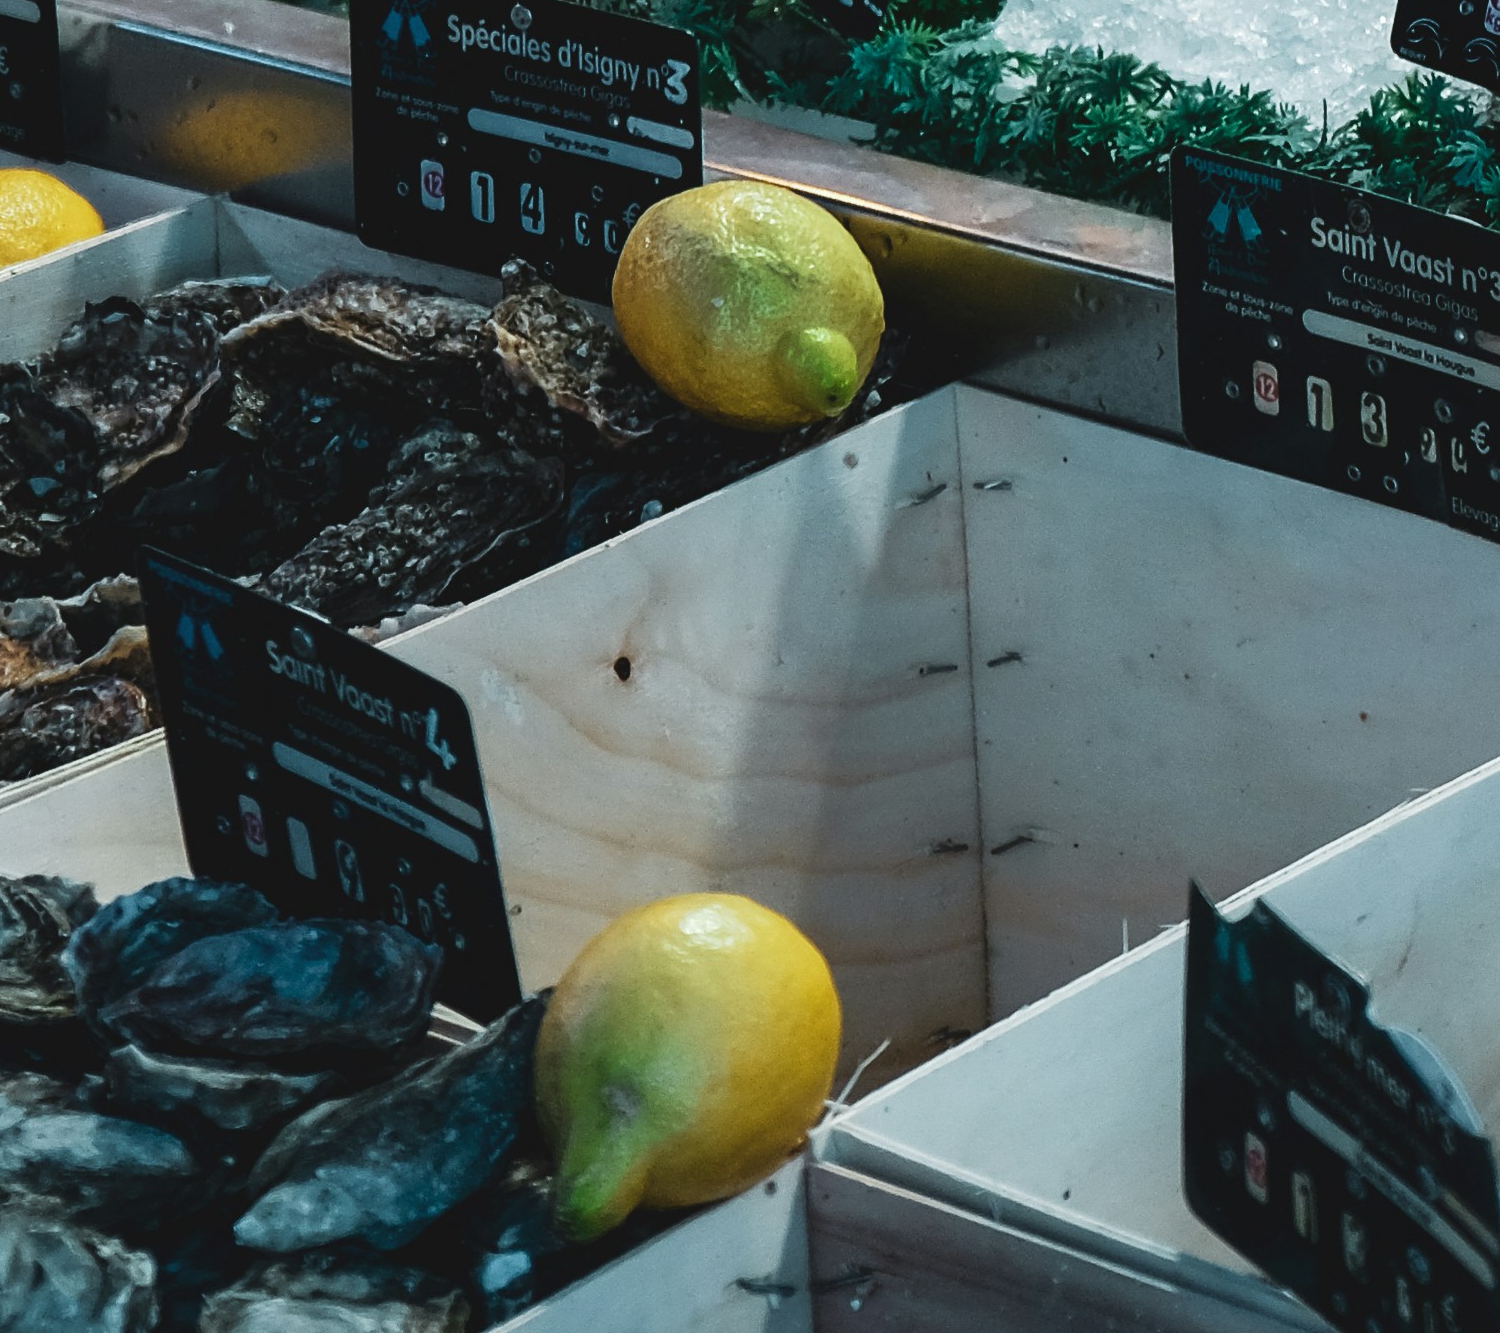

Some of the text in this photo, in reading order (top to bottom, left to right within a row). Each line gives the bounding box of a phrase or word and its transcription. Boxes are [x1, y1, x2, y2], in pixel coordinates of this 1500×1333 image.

[446, 13, 551, 64] Spéciales
[556, 39, 640, 92] d'Isigny
[504, 64, 587, 100] Crassostrea
[1310, 216, 1378, 262] Saint
[1382, 235, 1456, 287] Vaast
[1202, 280, 1229, 298] Zone
[1326, 291, 1351, 311] Type
[1390, 311, 1404, 325] de
[1341, 265, 1479, 324] Crassostrea Gigas
[1469, 419, 1491, 455] €
[265, 639, 327, 694] Saint
